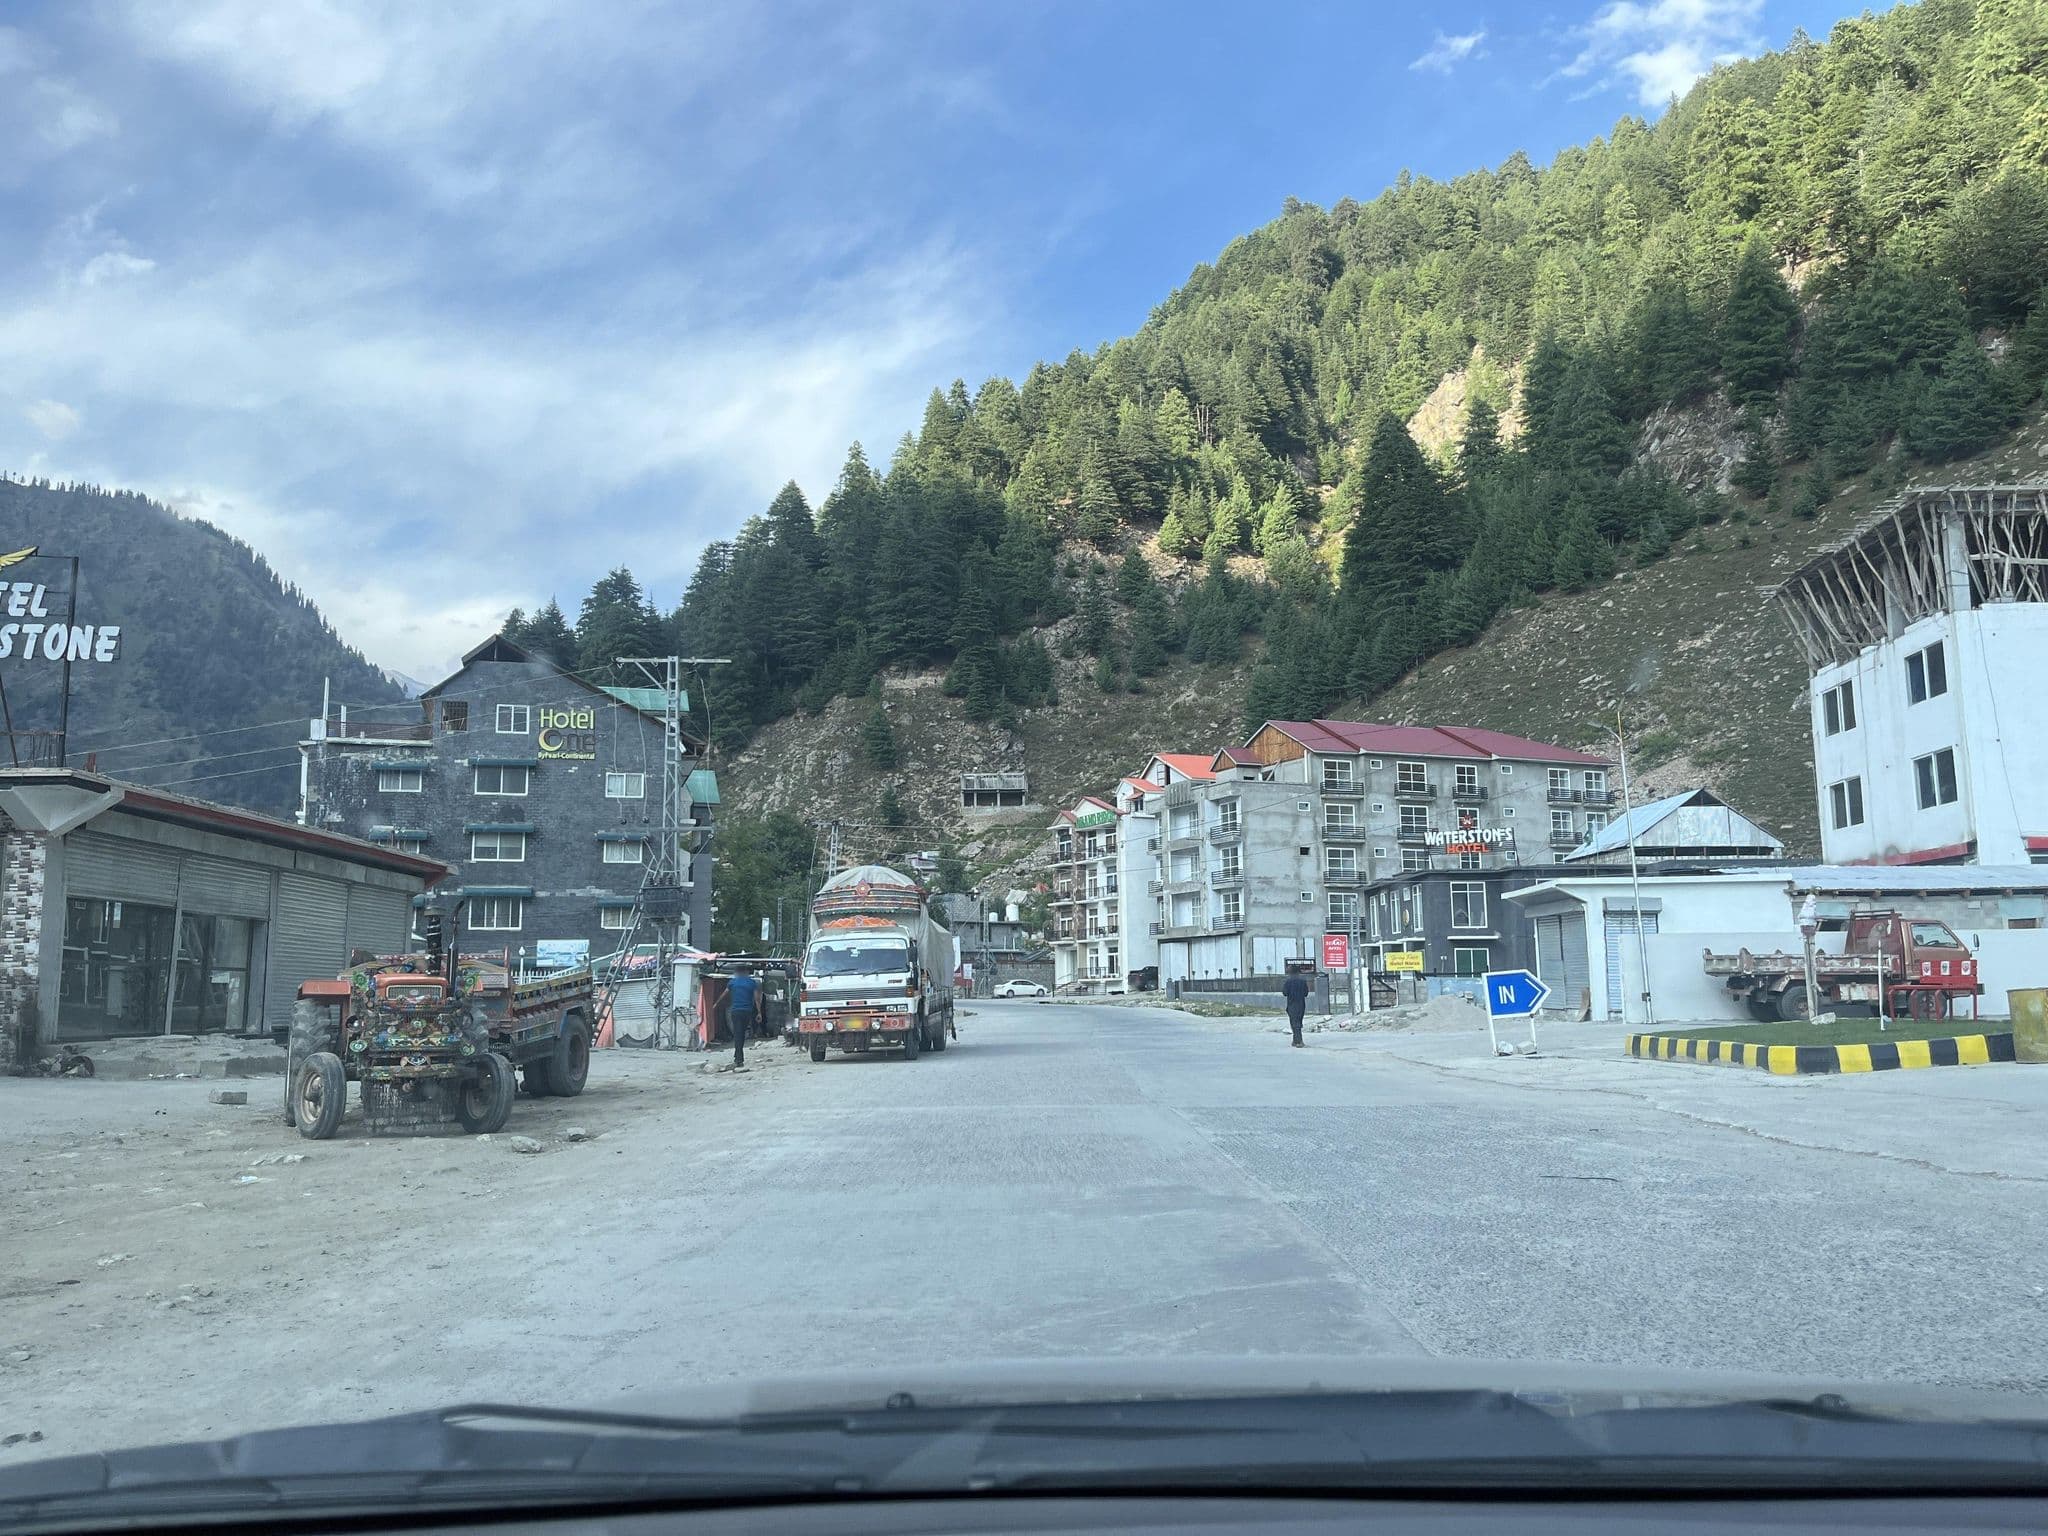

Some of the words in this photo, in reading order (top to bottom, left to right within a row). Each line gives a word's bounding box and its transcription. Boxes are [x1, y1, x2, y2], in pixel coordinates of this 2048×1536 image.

[0, 623, 120, 662] STONE
[540, 708, 594, 730] Hotel
[1446, 842, 1490, 854] HOTEL
[1498, 984, 1516, 1005] IN
